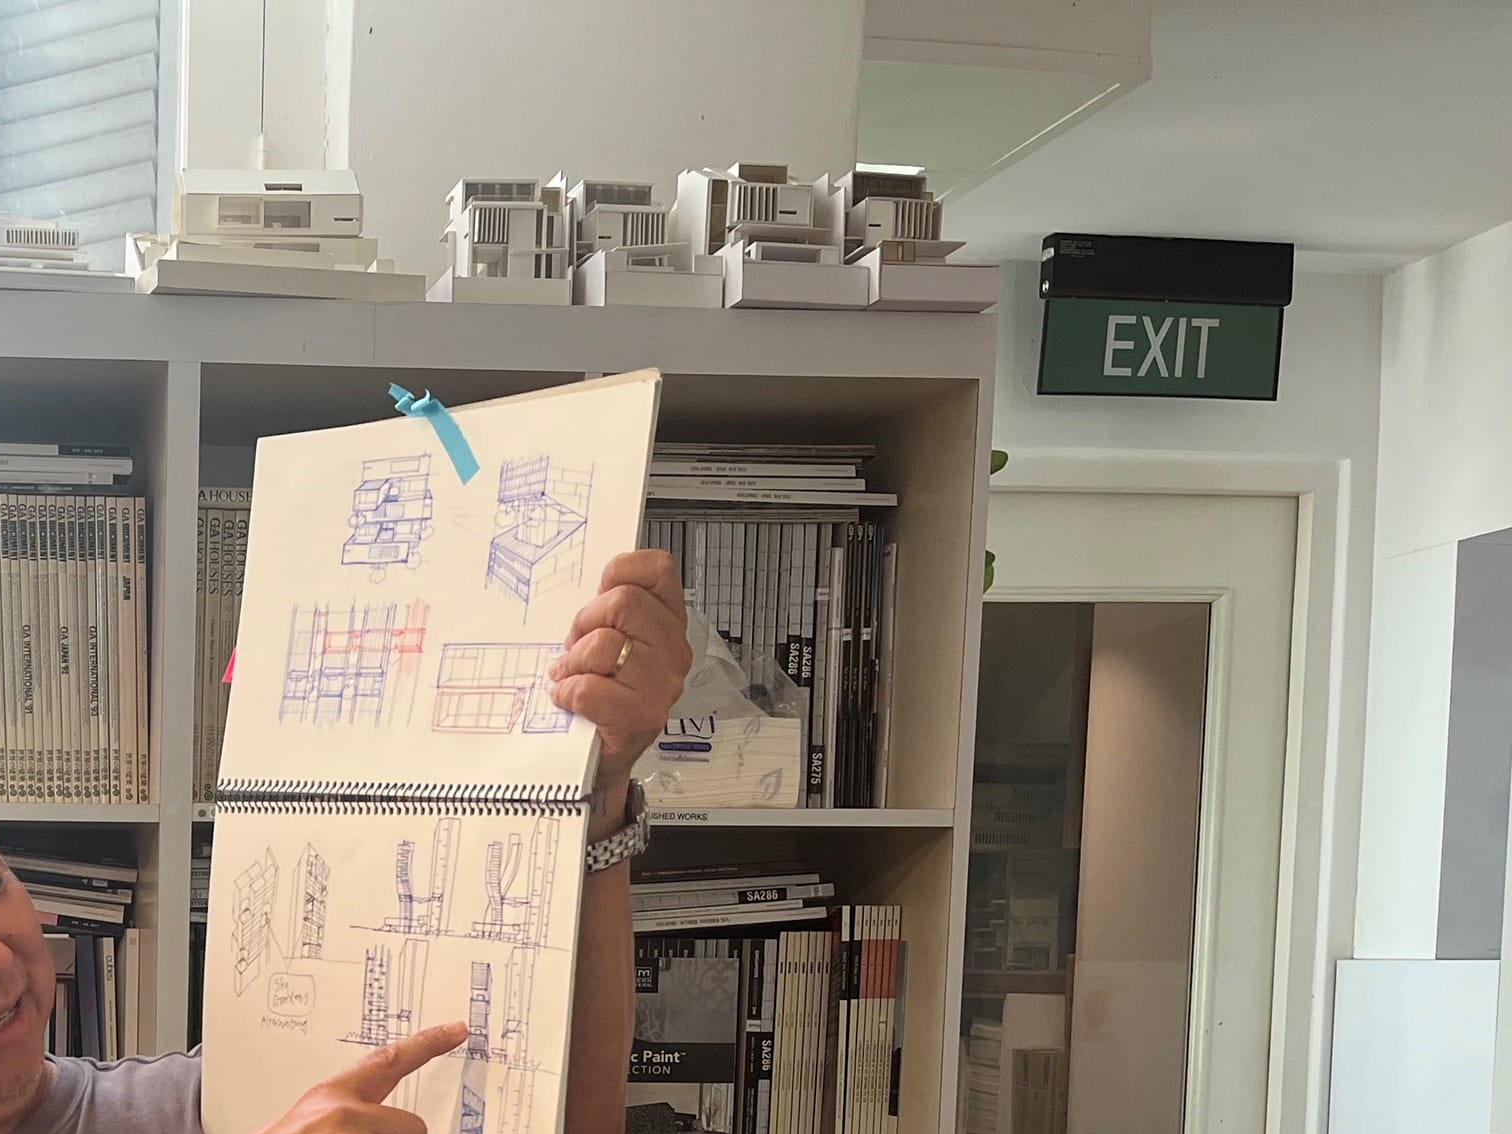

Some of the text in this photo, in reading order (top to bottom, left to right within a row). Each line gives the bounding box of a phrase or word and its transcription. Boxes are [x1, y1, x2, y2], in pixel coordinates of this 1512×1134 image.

[1103, 314, 1220, 379] EXIT
[209, 518, 220, 594] GA HOUSES
[23, 641, 32, 702] INTERNATIONAL
[89, 642, 98, 703] INTERNATIONAL
[788, 643, 800, 675] SA286
[801, 646, 813, 678] SA286
[811, 753, 823, 785] SA275
[650, 812, 708, 821] ISHED WORKS
[746, 889, 779, 902] SA286
[105, 954, 115, 981] cubes
